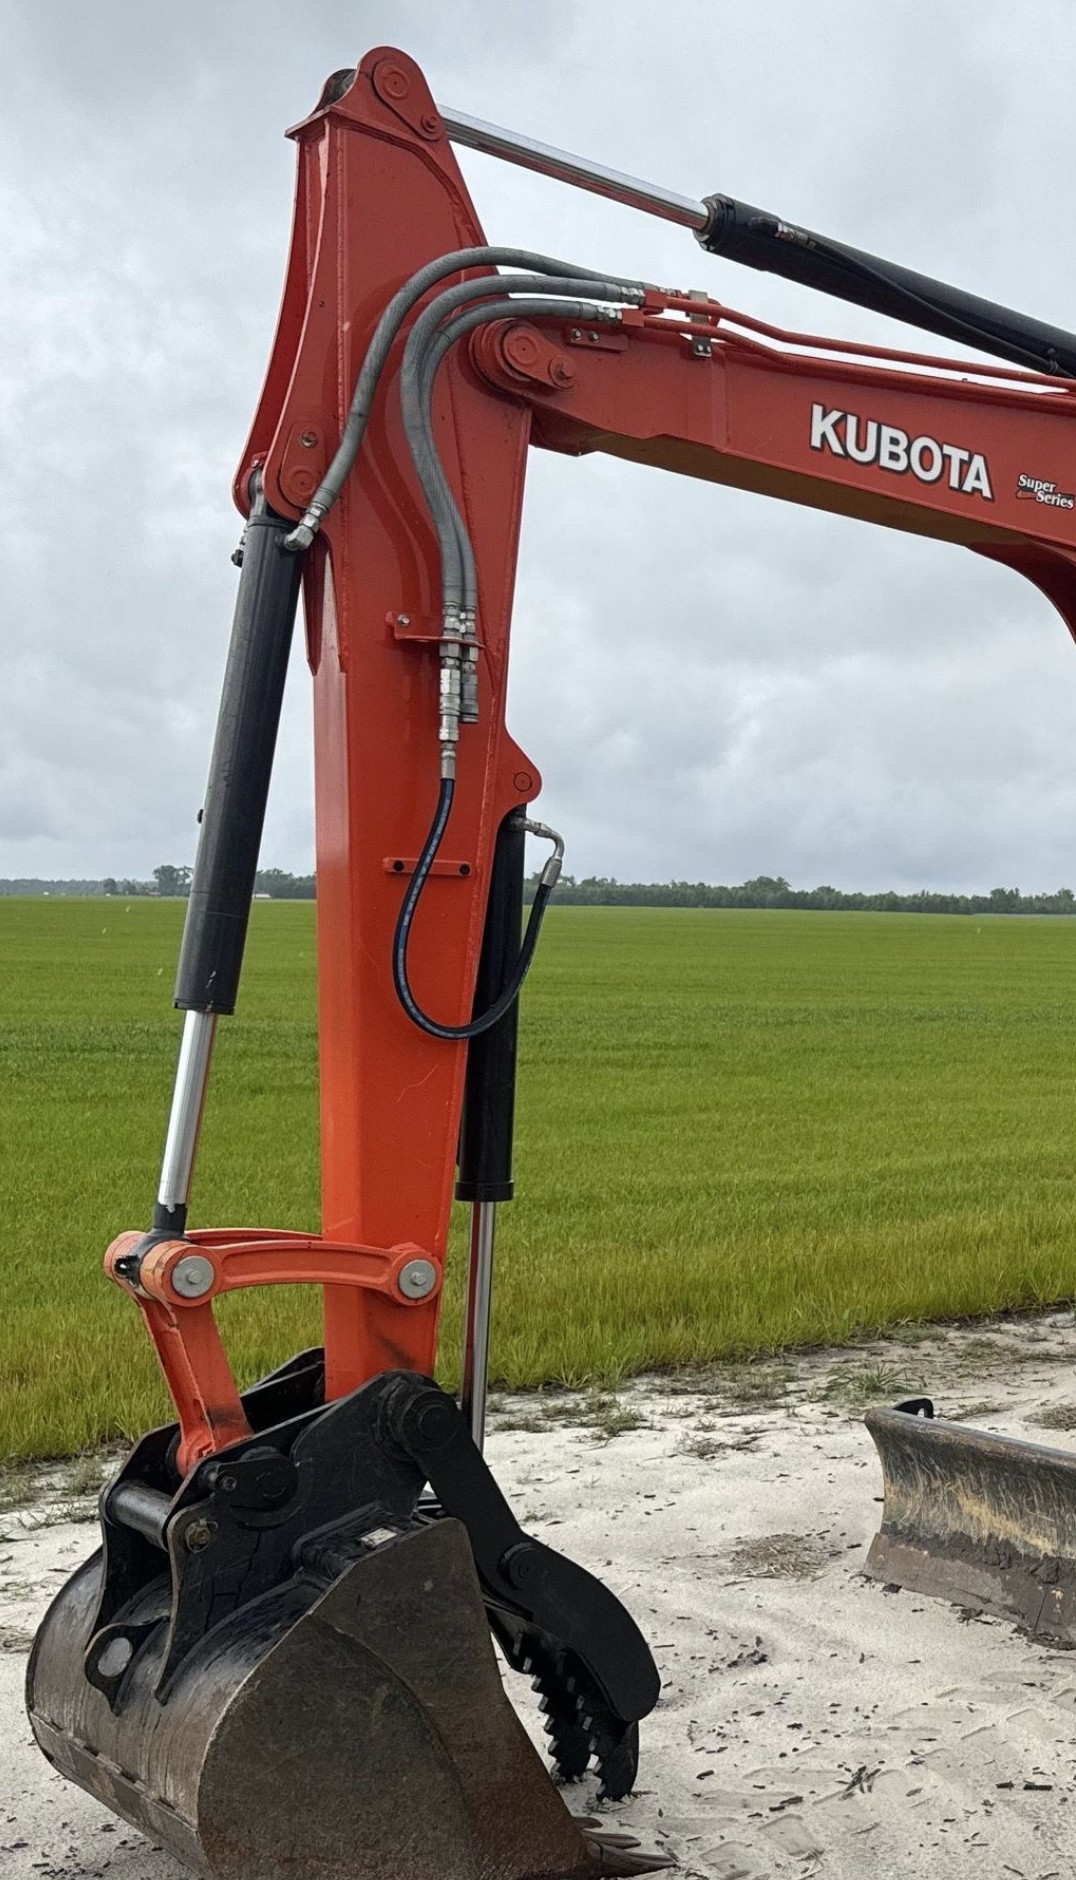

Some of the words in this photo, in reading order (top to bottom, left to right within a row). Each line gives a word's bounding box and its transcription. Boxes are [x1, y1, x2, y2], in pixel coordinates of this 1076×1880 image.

[810, 402, 994, 500] KUBOTA
[1018, 473, 1056, 492] Super
[1035, 490, 1074, 509] Series
